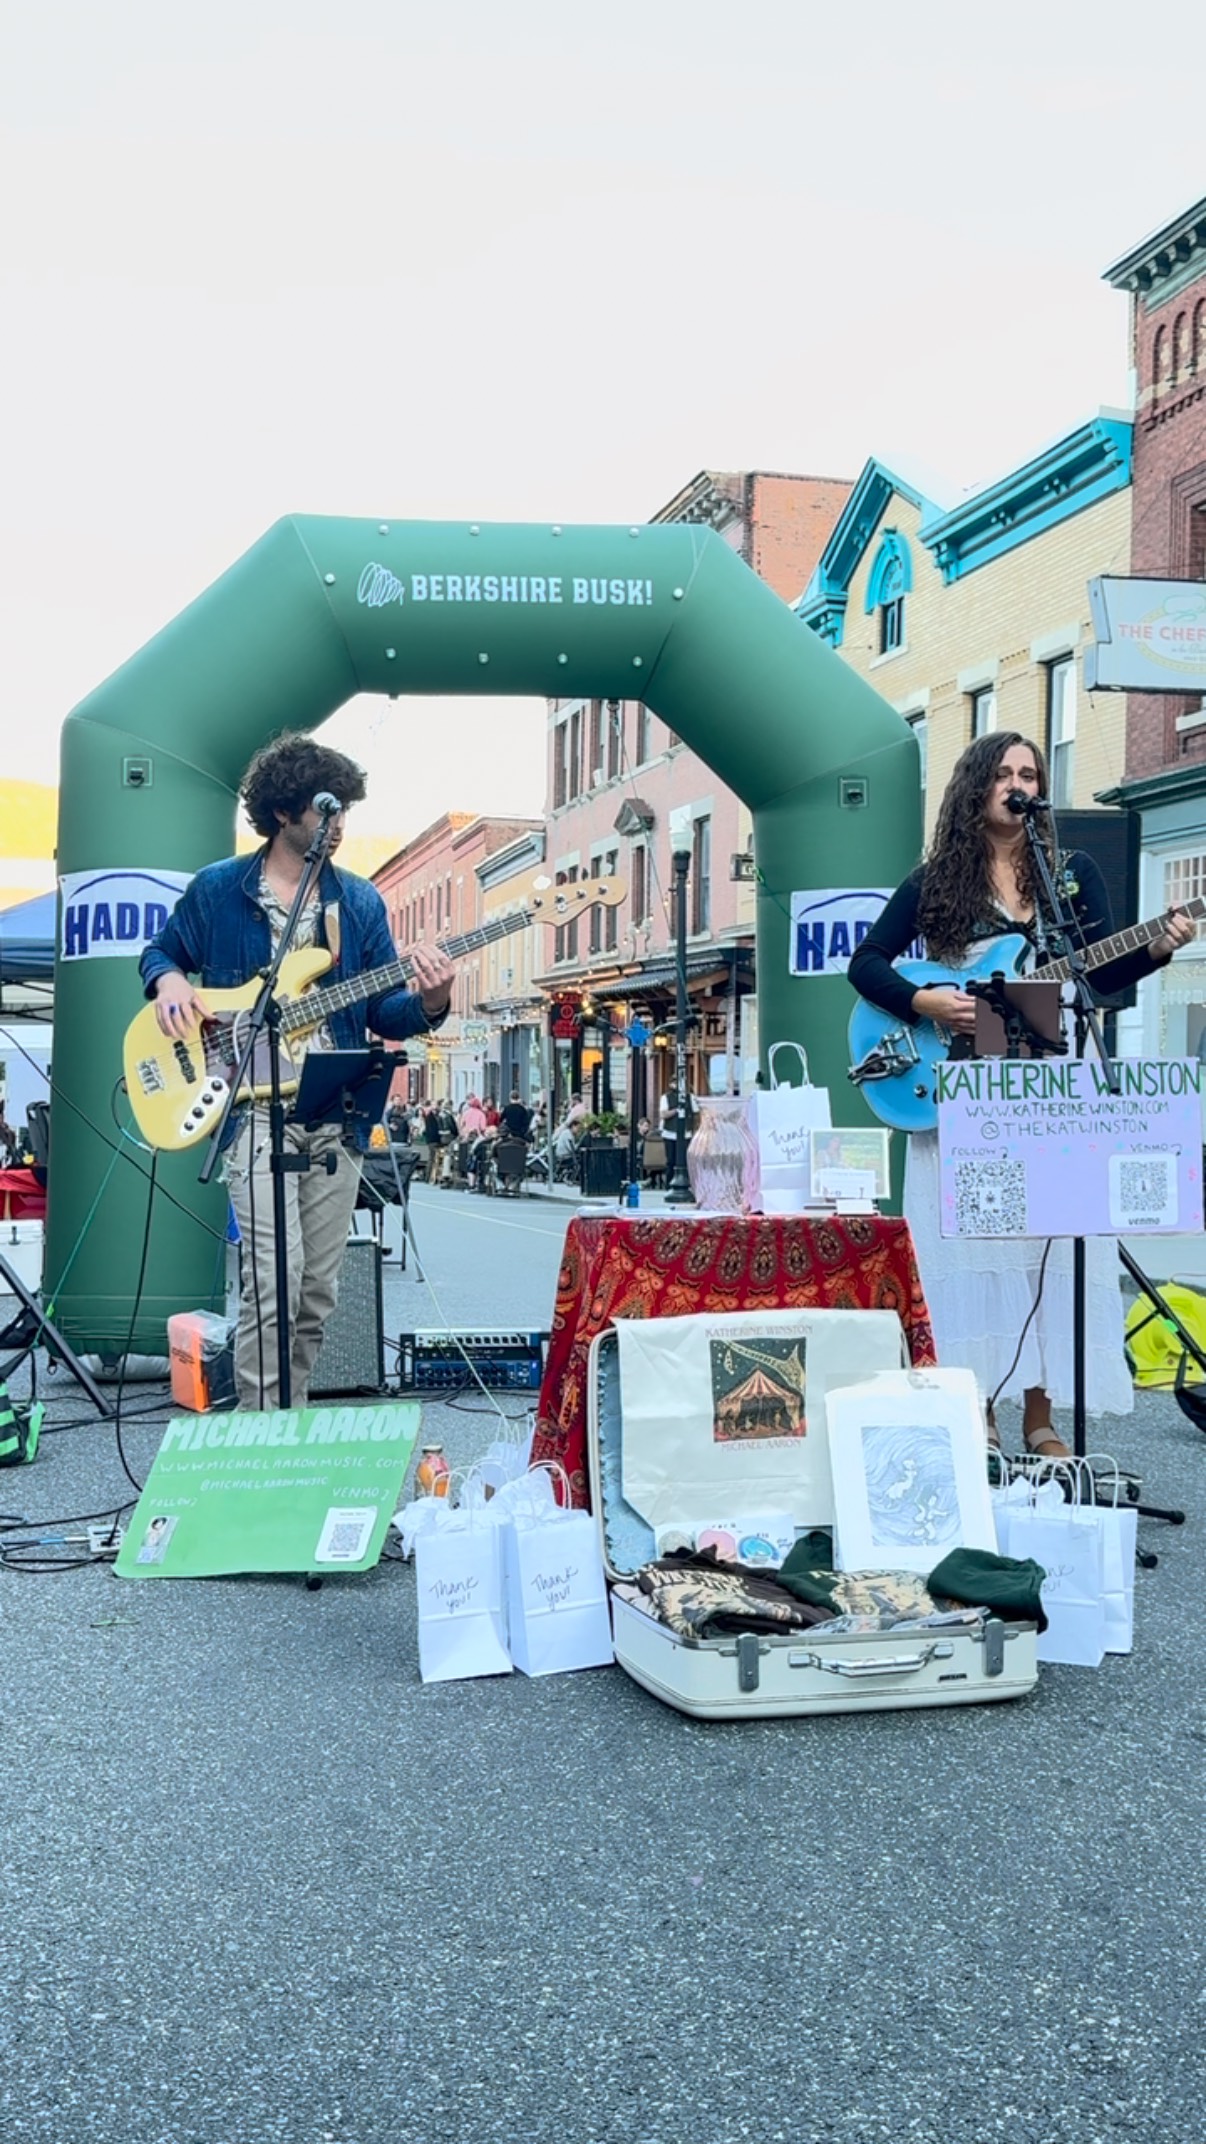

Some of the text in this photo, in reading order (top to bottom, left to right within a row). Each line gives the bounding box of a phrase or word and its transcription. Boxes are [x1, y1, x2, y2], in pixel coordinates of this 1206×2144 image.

[411, 574, 653, 606] BERKSHIRE BUSK!
[1118, 623, 1153, 639] THE
[64, 901, 168, 957] HADD
[938, 1061, 1082, 1103] KATHERINE
[980, 1119, 1149, 1140] @THEKATWINSTON
[950, 1147, 998, 1157] FOLLOW
[1130, 1143, 1169, 1153] VENMO
[1127, 1215, 1161, 1226] venmo
[159, 1402, 421, 1452] MICHAEL AARON
[332, 1486, 380, 1499] VENMO
[429, 1576, 479, 1599] Thank
[531, 1565, 579, 1593] Thank
